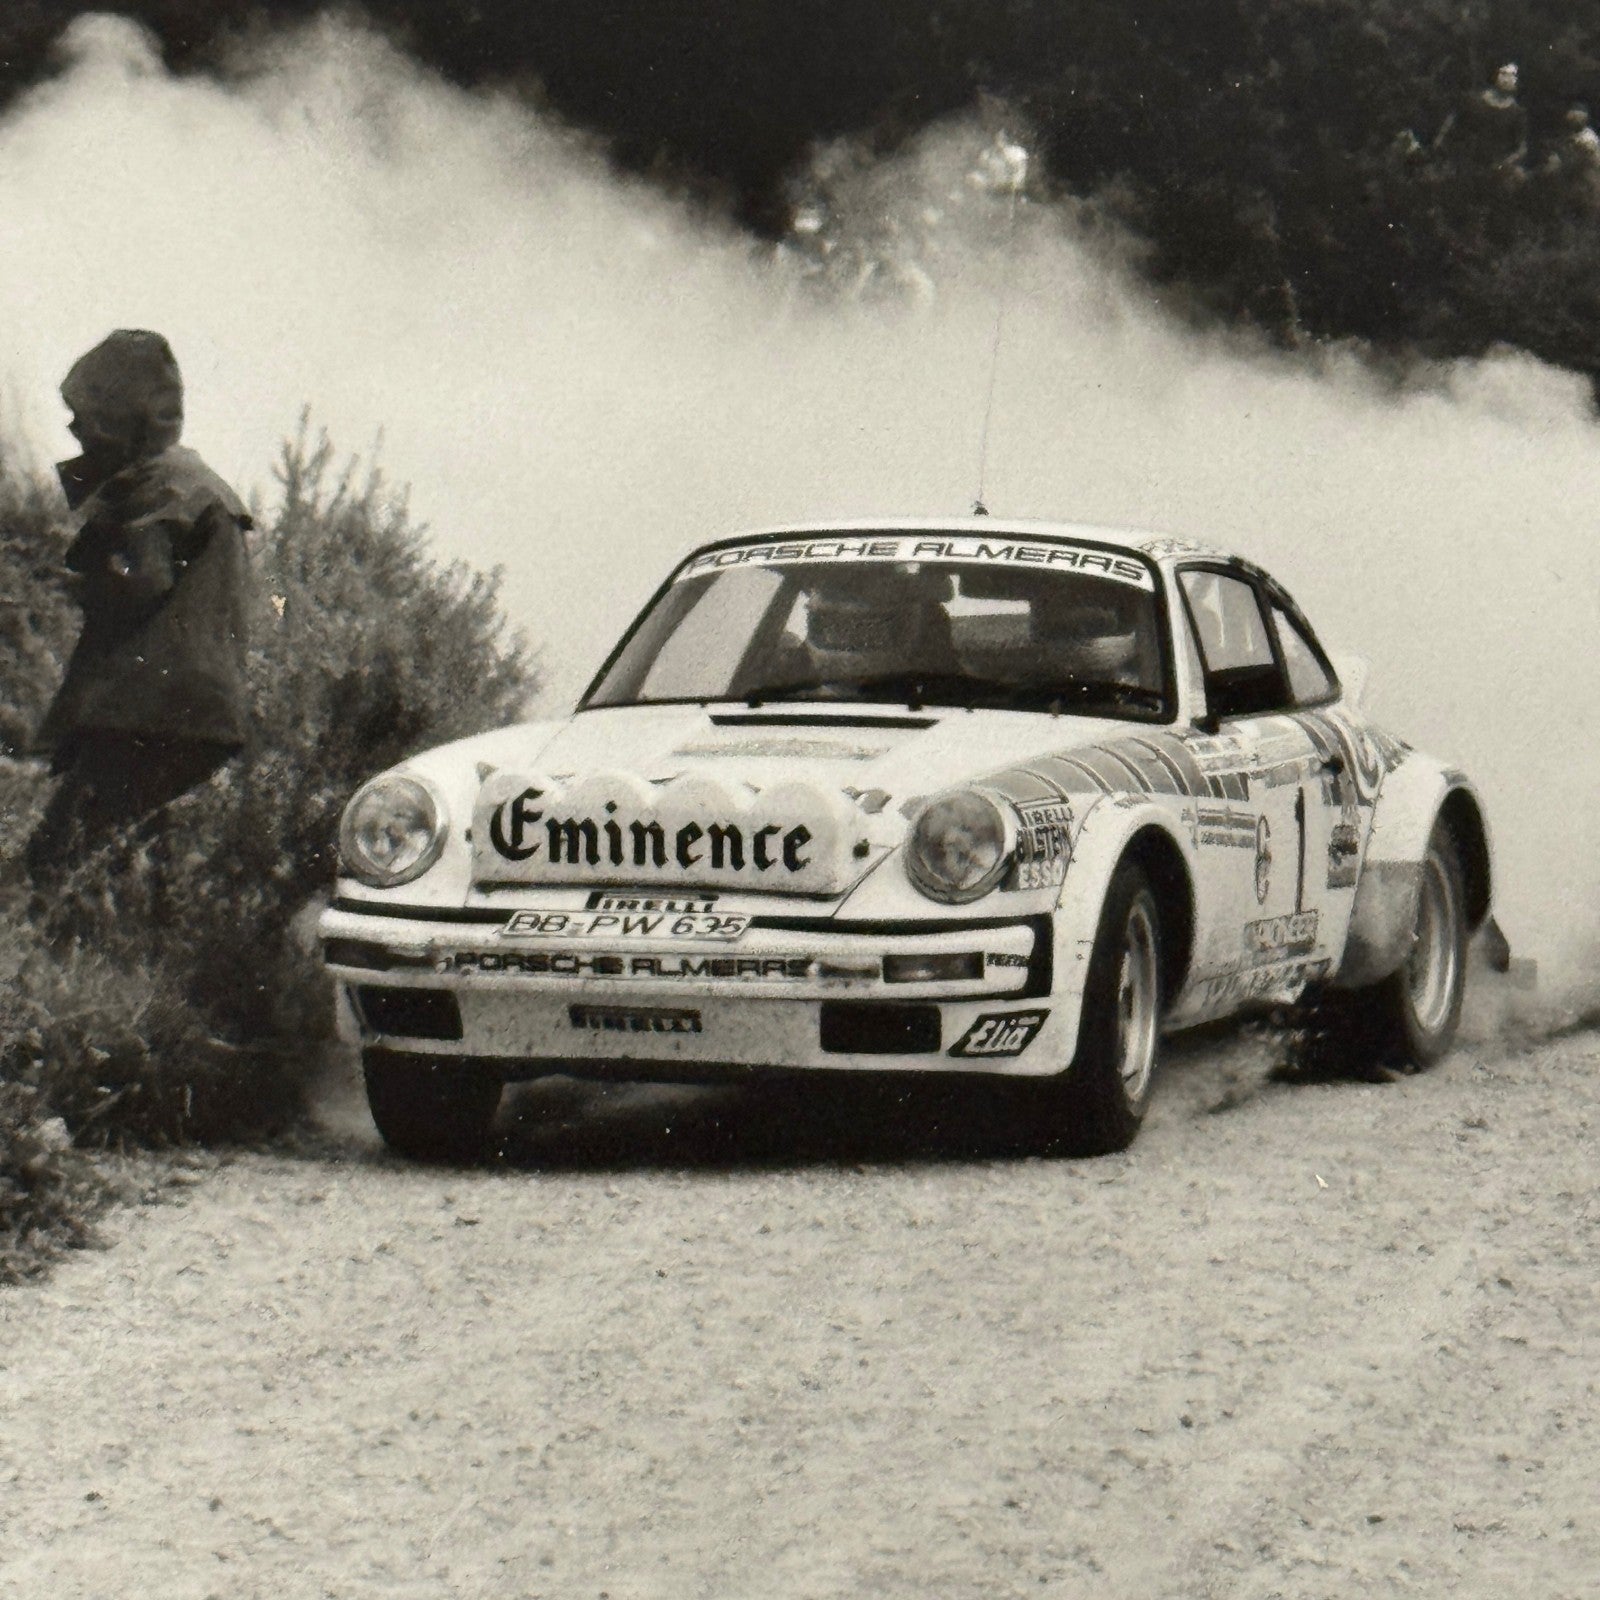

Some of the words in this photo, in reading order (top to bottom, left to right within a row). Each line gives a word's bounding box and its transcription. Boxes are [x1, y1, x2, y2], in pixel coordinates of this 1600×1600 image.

[688, 541, 899, 572] PORSCHE
[912, 542, 1146, 581] ALMERAS
[489, 787, 813, 872] Eminence
[585, 891, 719, 913] PIRELLI
[670, 915, 748, 936] 635
[455, 952, 624, 975] PORSCHE
[631, 957, 812, 977] ALMERAS
